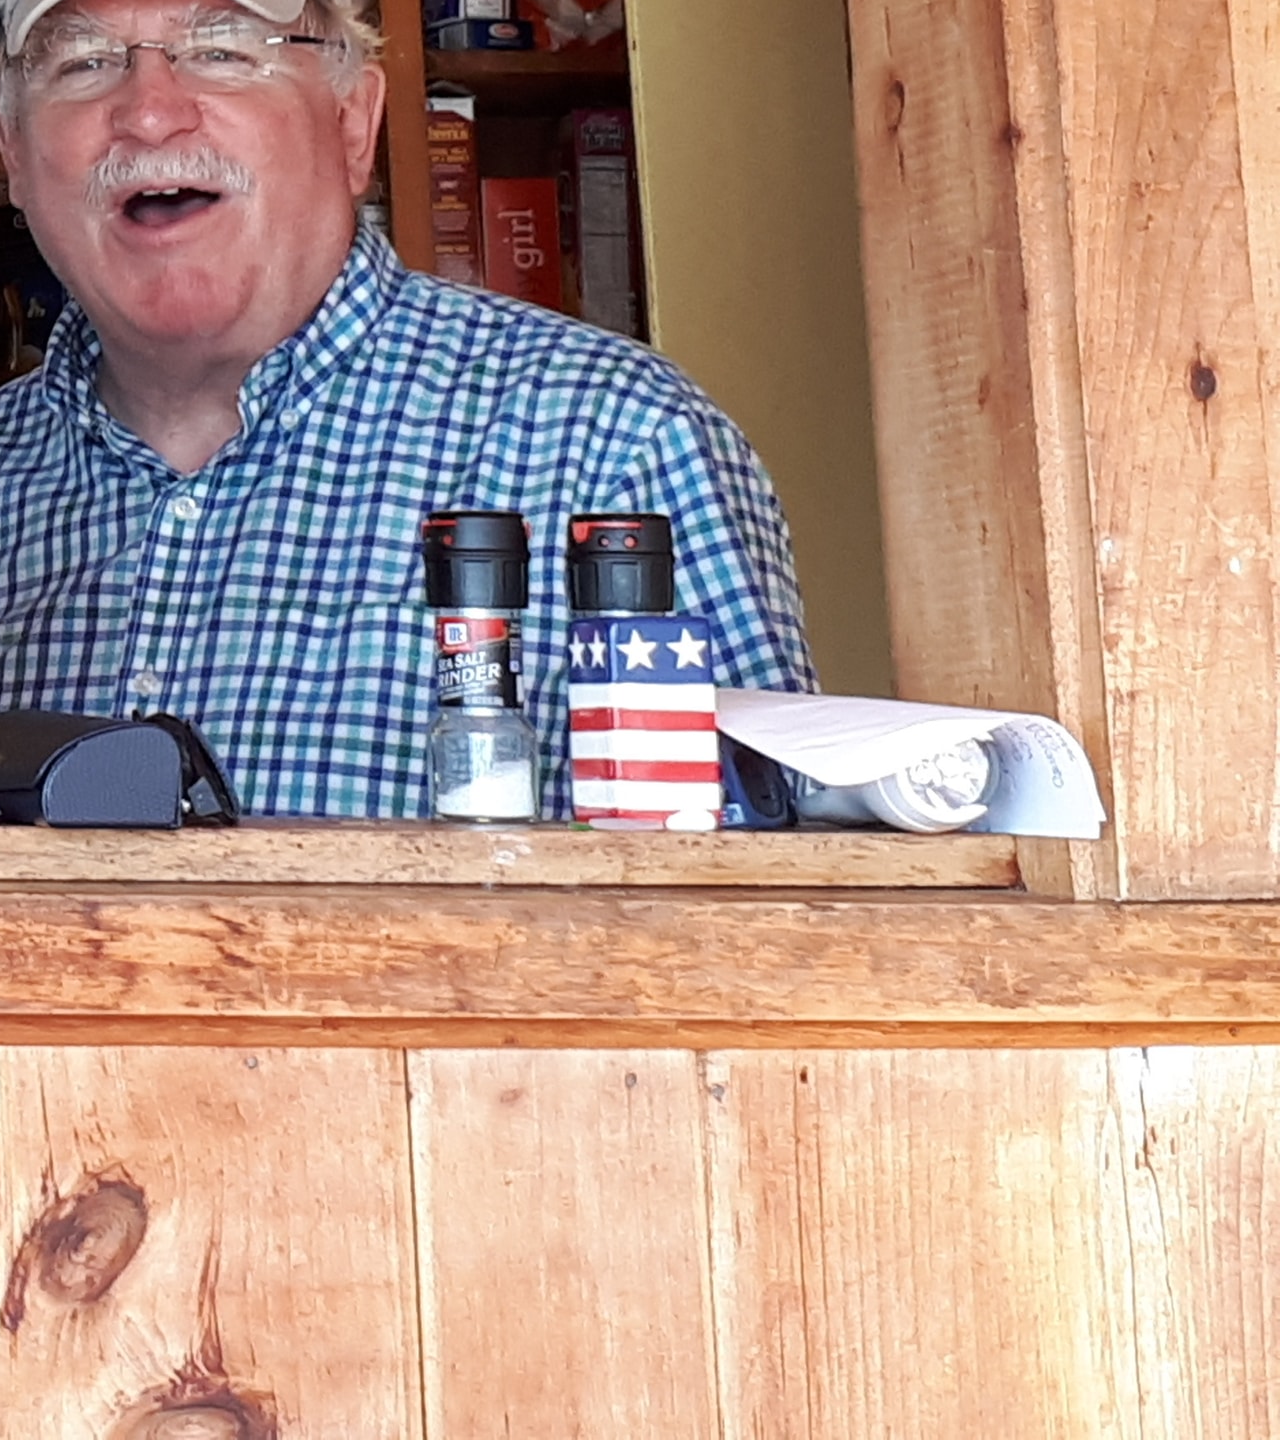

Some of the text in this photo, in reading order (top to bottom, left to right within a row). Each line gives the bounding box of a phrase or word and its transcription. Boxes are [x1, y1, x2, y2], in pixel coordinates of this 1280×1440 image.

[497, 209, 544, 269] girl
[455, 651, 486, 668] SALT
[438, 663, 501, 687] RINDER
